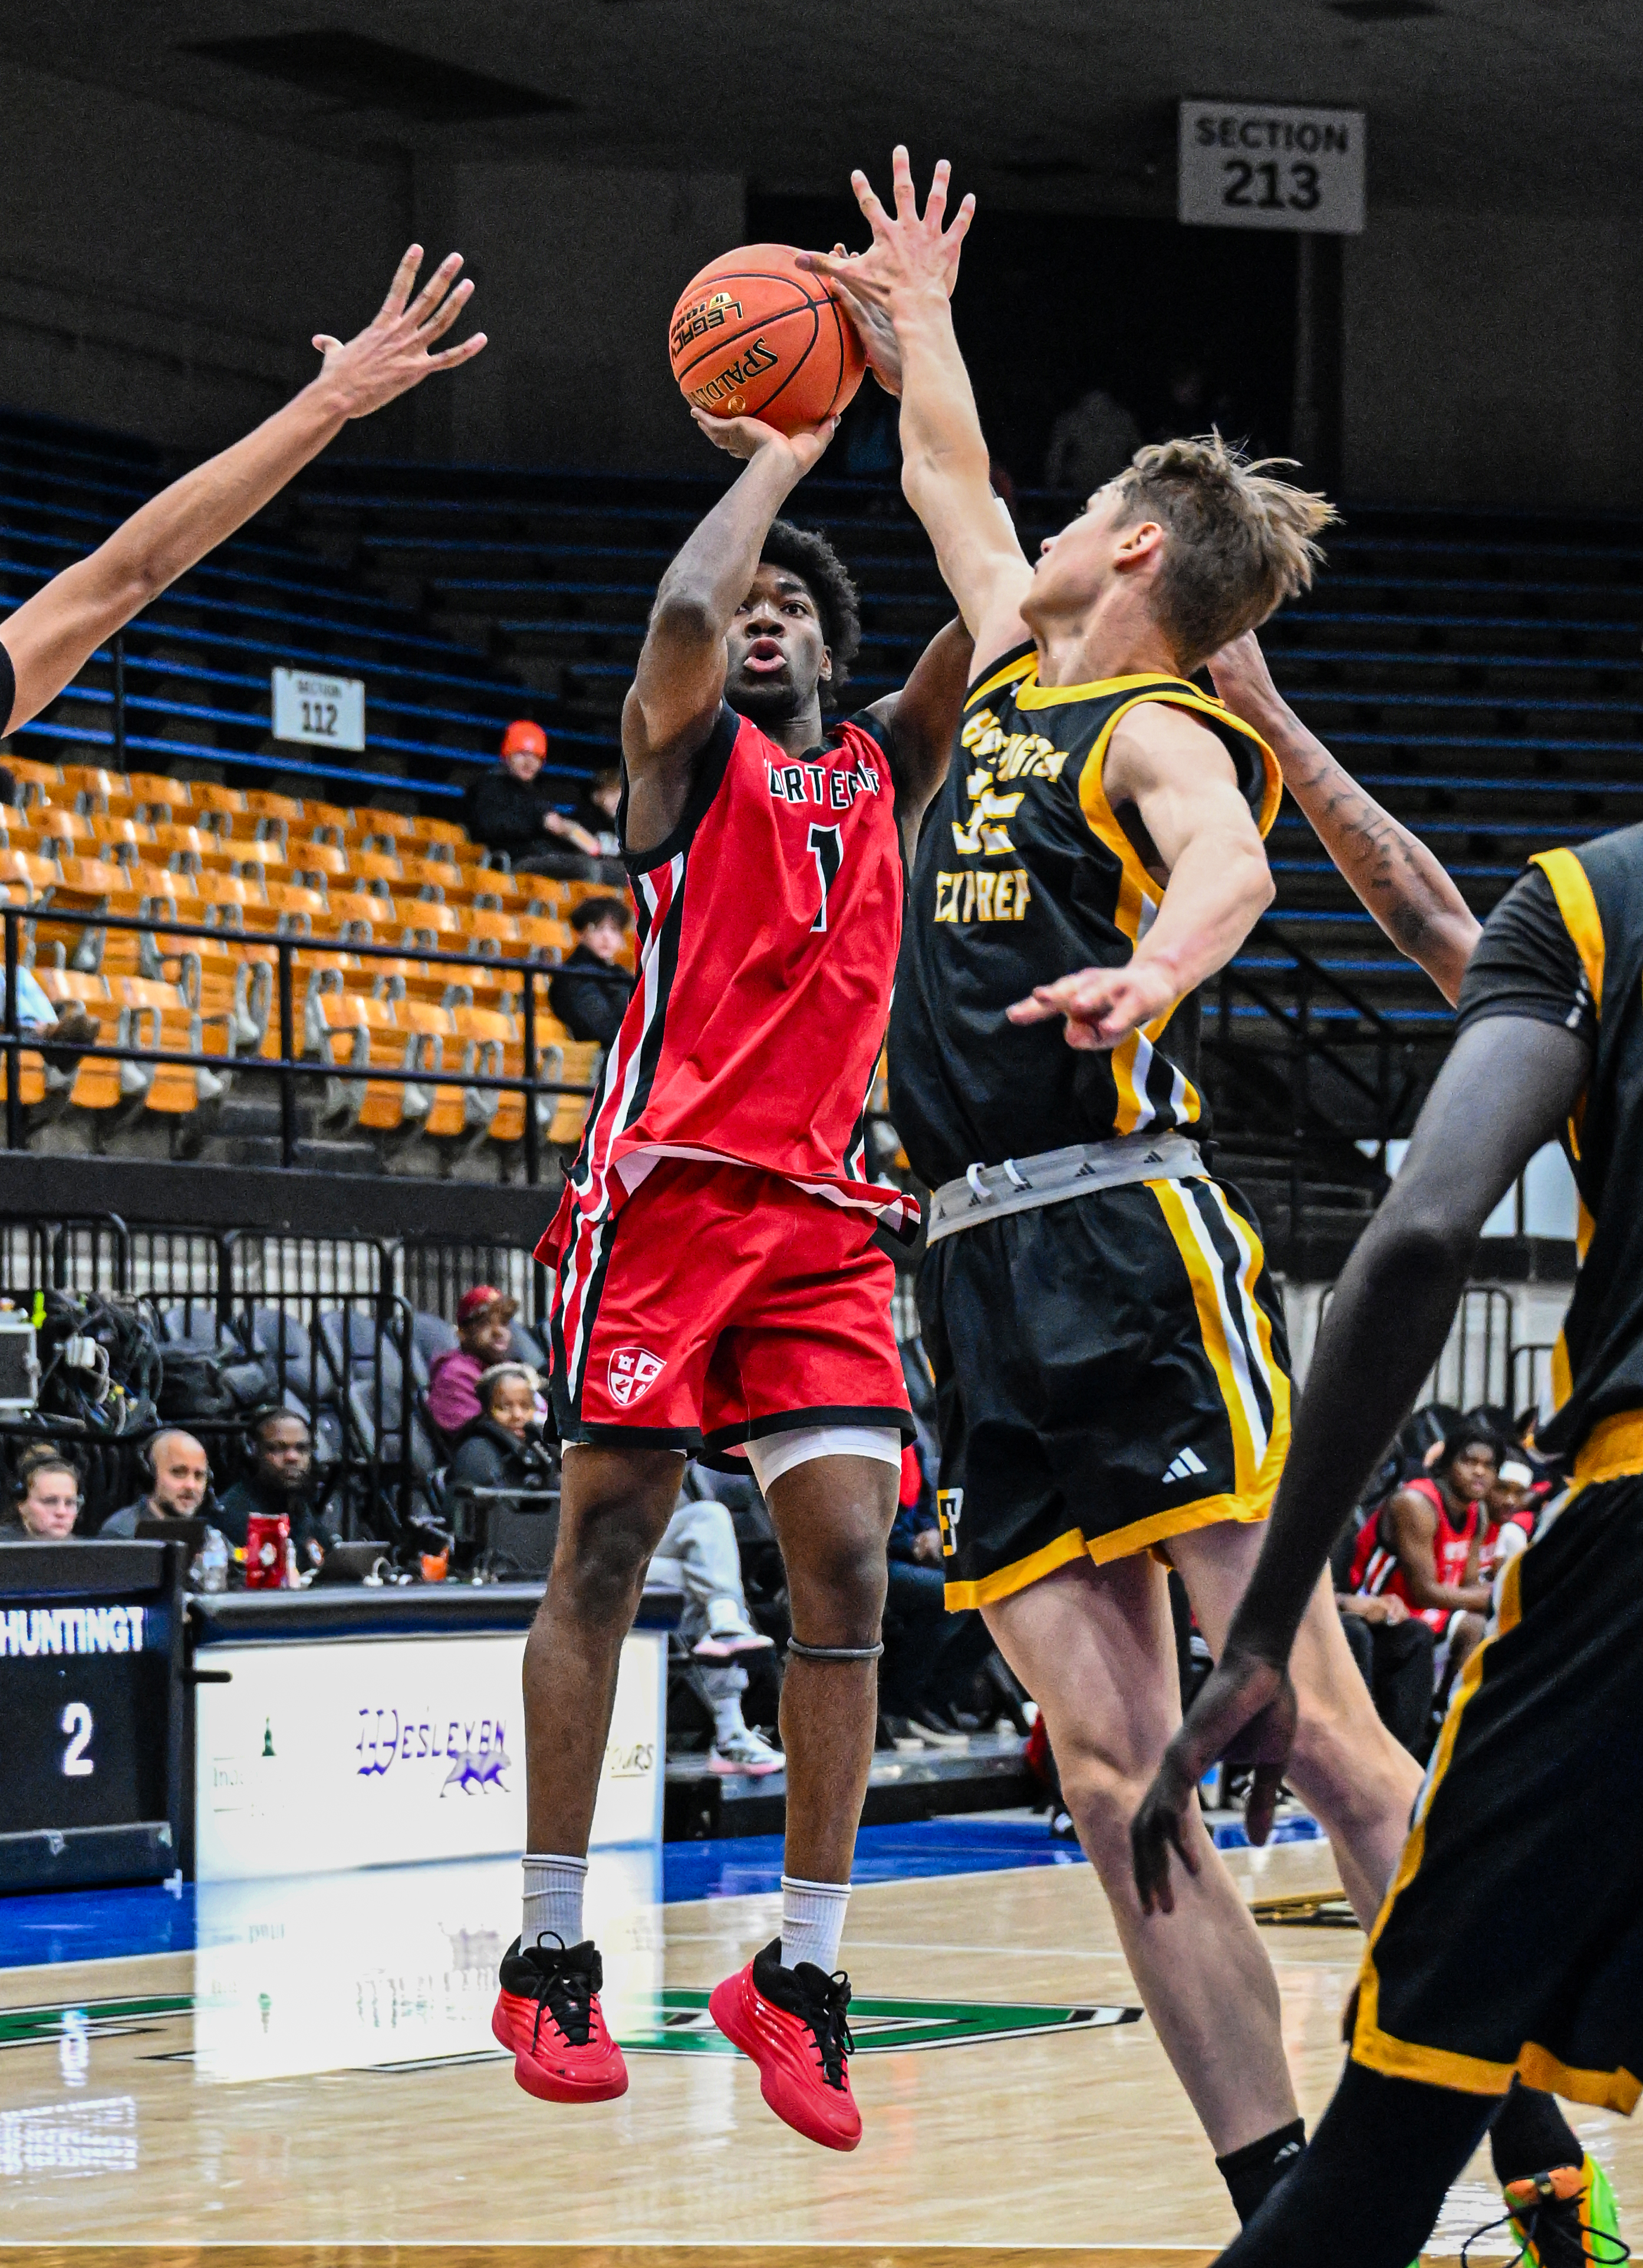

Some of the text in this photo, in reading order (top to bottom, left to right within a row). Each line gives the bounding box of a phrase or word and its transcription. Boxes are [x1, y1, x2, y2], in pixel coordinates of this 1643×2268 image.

[1196, 117, 1349, 156] SECTION
[1223, 159, 1321, 212] 213
[301, 701, 338, 736] 112
[806, 822, 844, 933] 1
[0, 1606, 144, 1657] HUNTINGT
[62, 1702, 94, 1776] 2
